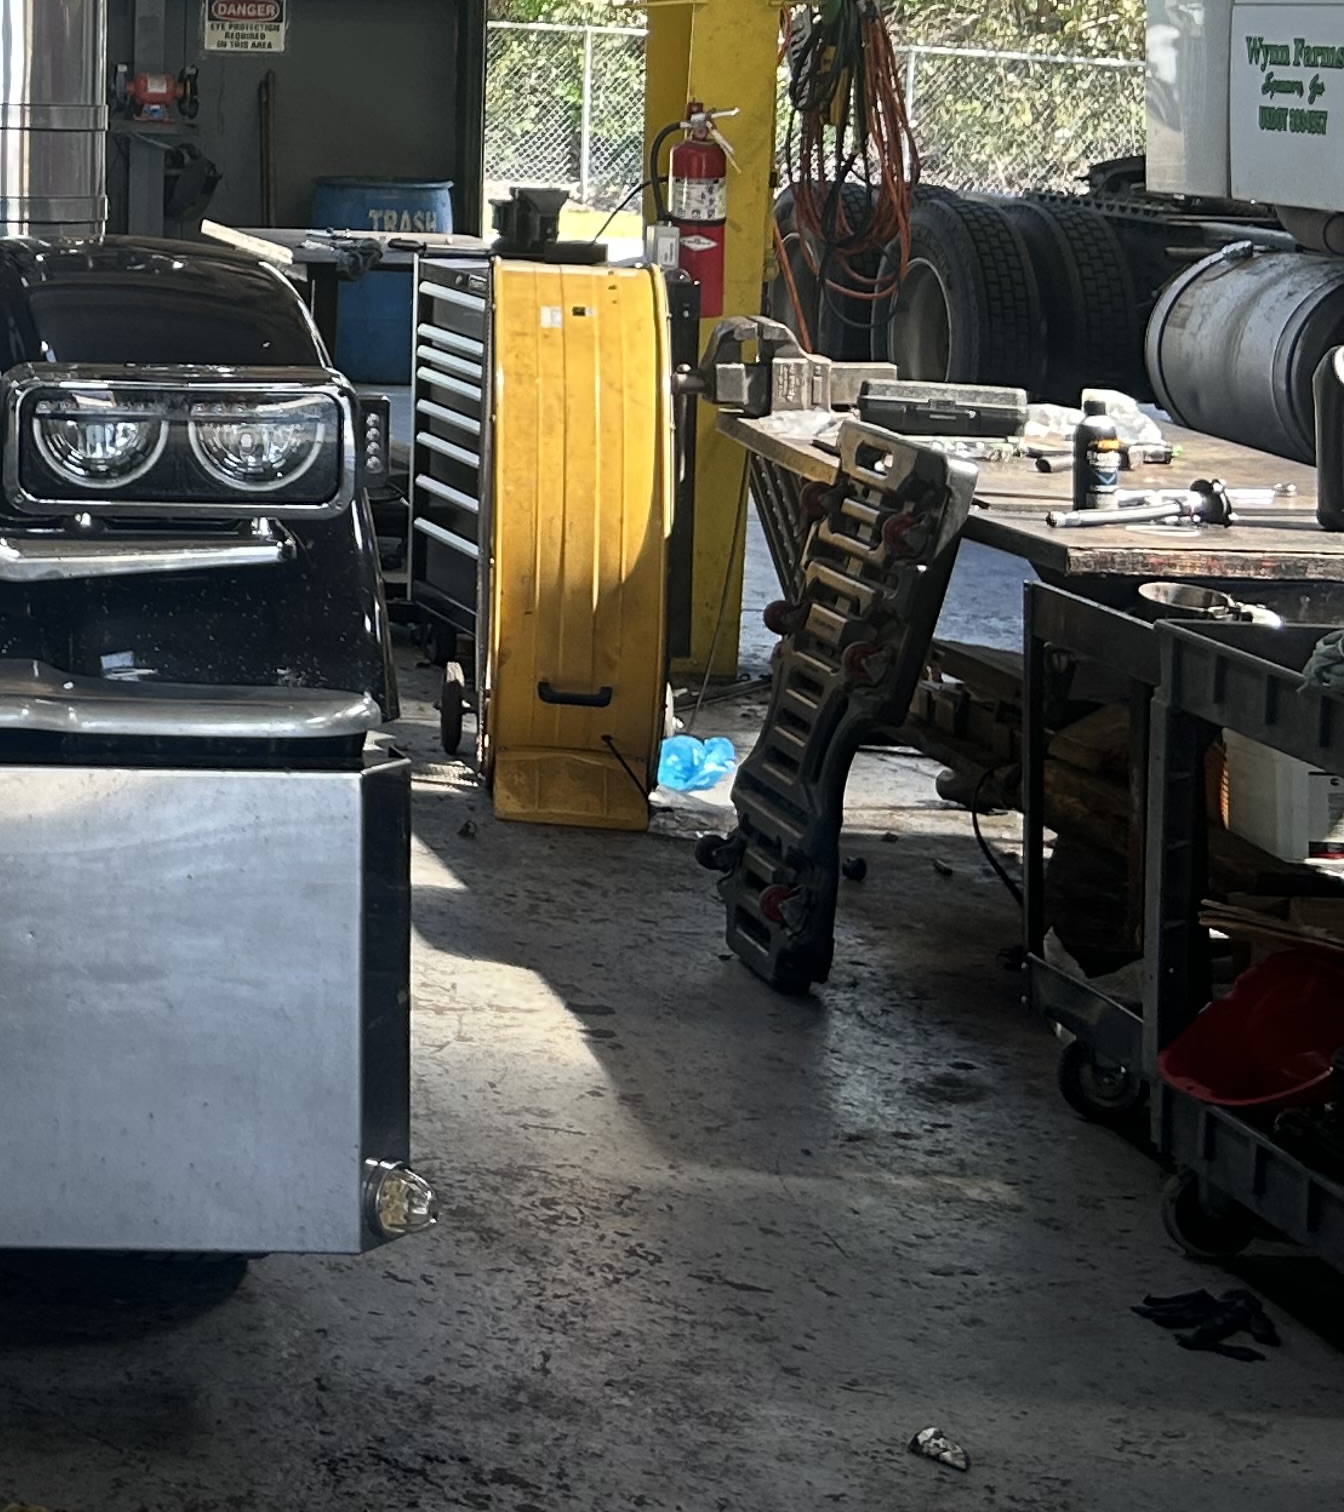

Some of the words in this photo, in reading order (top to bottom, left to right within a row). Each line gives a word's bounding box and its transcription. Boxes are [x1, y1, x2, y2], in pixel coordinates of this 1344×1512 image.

[217, 3, 277, 17] DANGER
[1246, 36, 1290, 72] Wynn
[1292, 38, 1344, 69] Farms
[368, 209, 437, 232] TRASH
